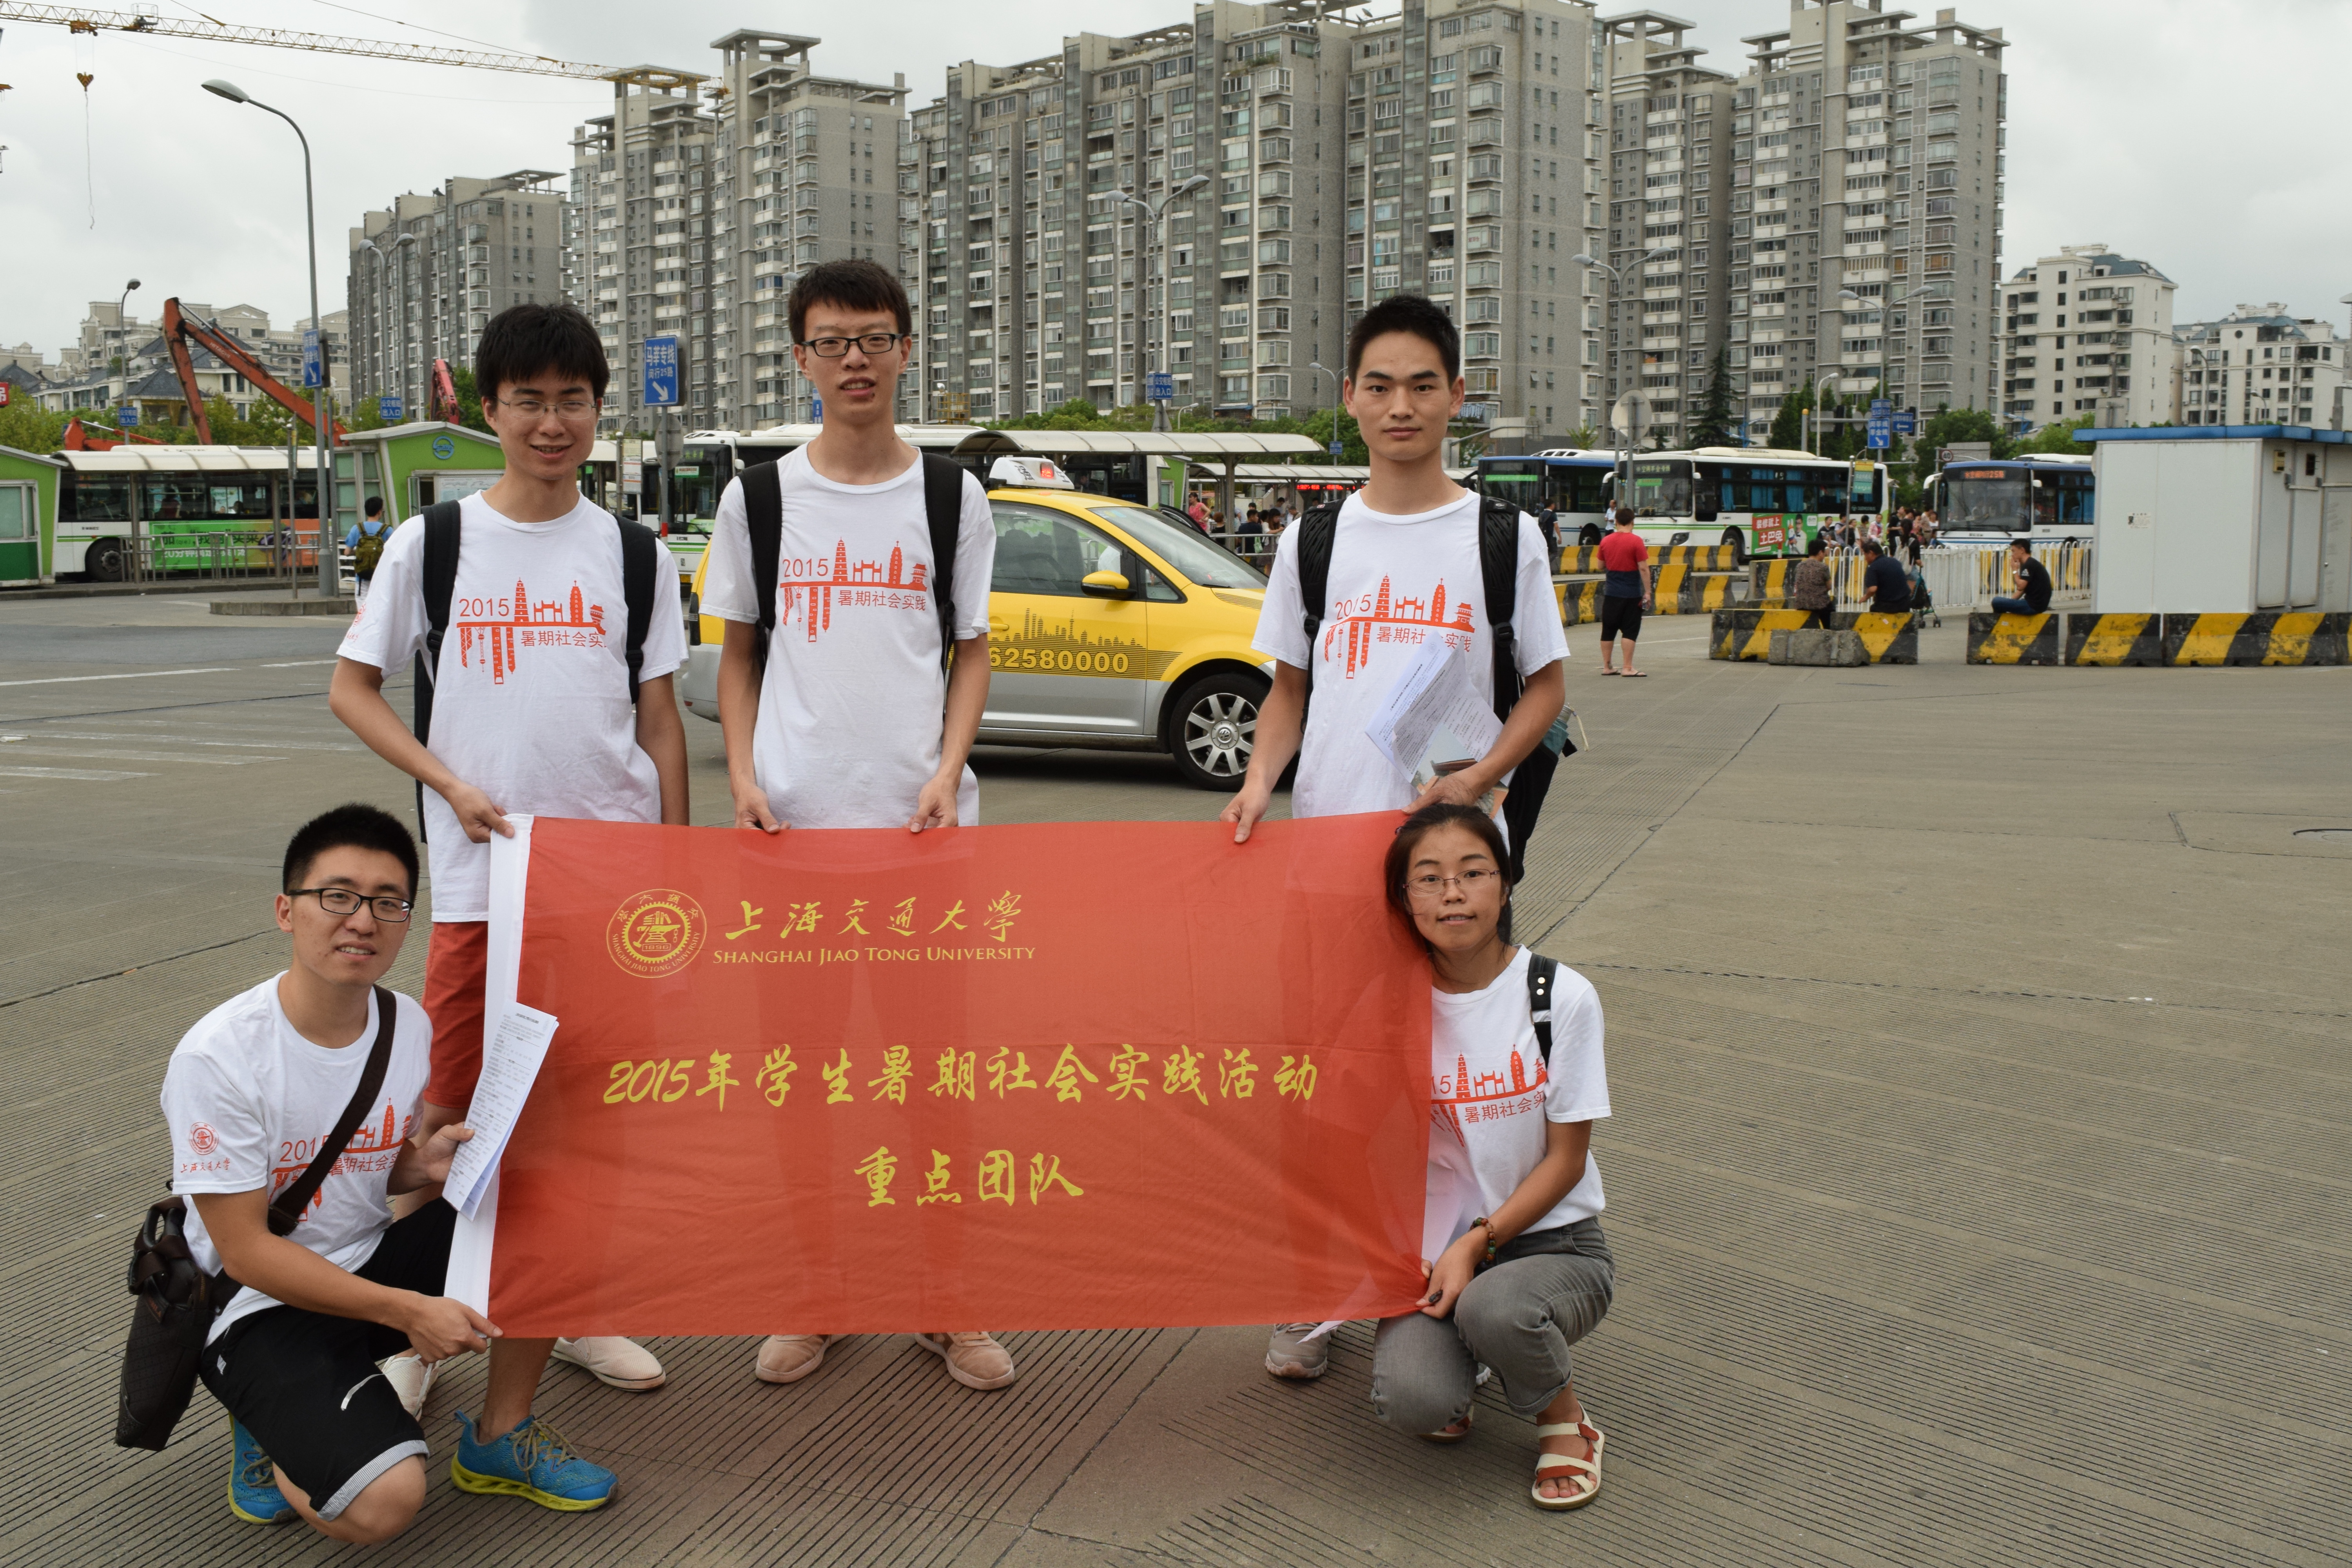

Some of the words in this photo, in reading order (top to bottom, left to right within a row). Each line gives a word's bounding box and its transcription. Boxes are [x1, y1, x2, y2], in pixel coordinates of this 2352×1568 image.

[1156, 387, 1171, 396] 出入口
[1760, 530, 1783, 545] 土巴兔
[782, 559, 829, 577] 2015
[459, 598, 509, 617] 2015
[838, 590, 927, 611] 暑期社会实践
[1335, 594, 1371, 620] 2015
[521, 630, 606, 648] 暑期社会实
[989, 647, 1129, 673] 62580000
[613, 933, 632, 965] SHANGHAI
[630, 963, 647, 972] JIAO
[650, 963, 671, 972] TONG
[671, 931, 700, 967] UNIVERSITY
[713, 949, 813, 964] SHANGHAI
[819, 947, 859, 966] JIAO
[864, 947, 920, 962] TONG
[926, 946, 1036, 961] UNIVERSITY
[603, 1043, 1319, 1112] 2015年学生暑期社会实践活动
[1465, 1091, 1544, 1124] 暑期社会实
[854, 1145, 1084, 1207] 重点团队
